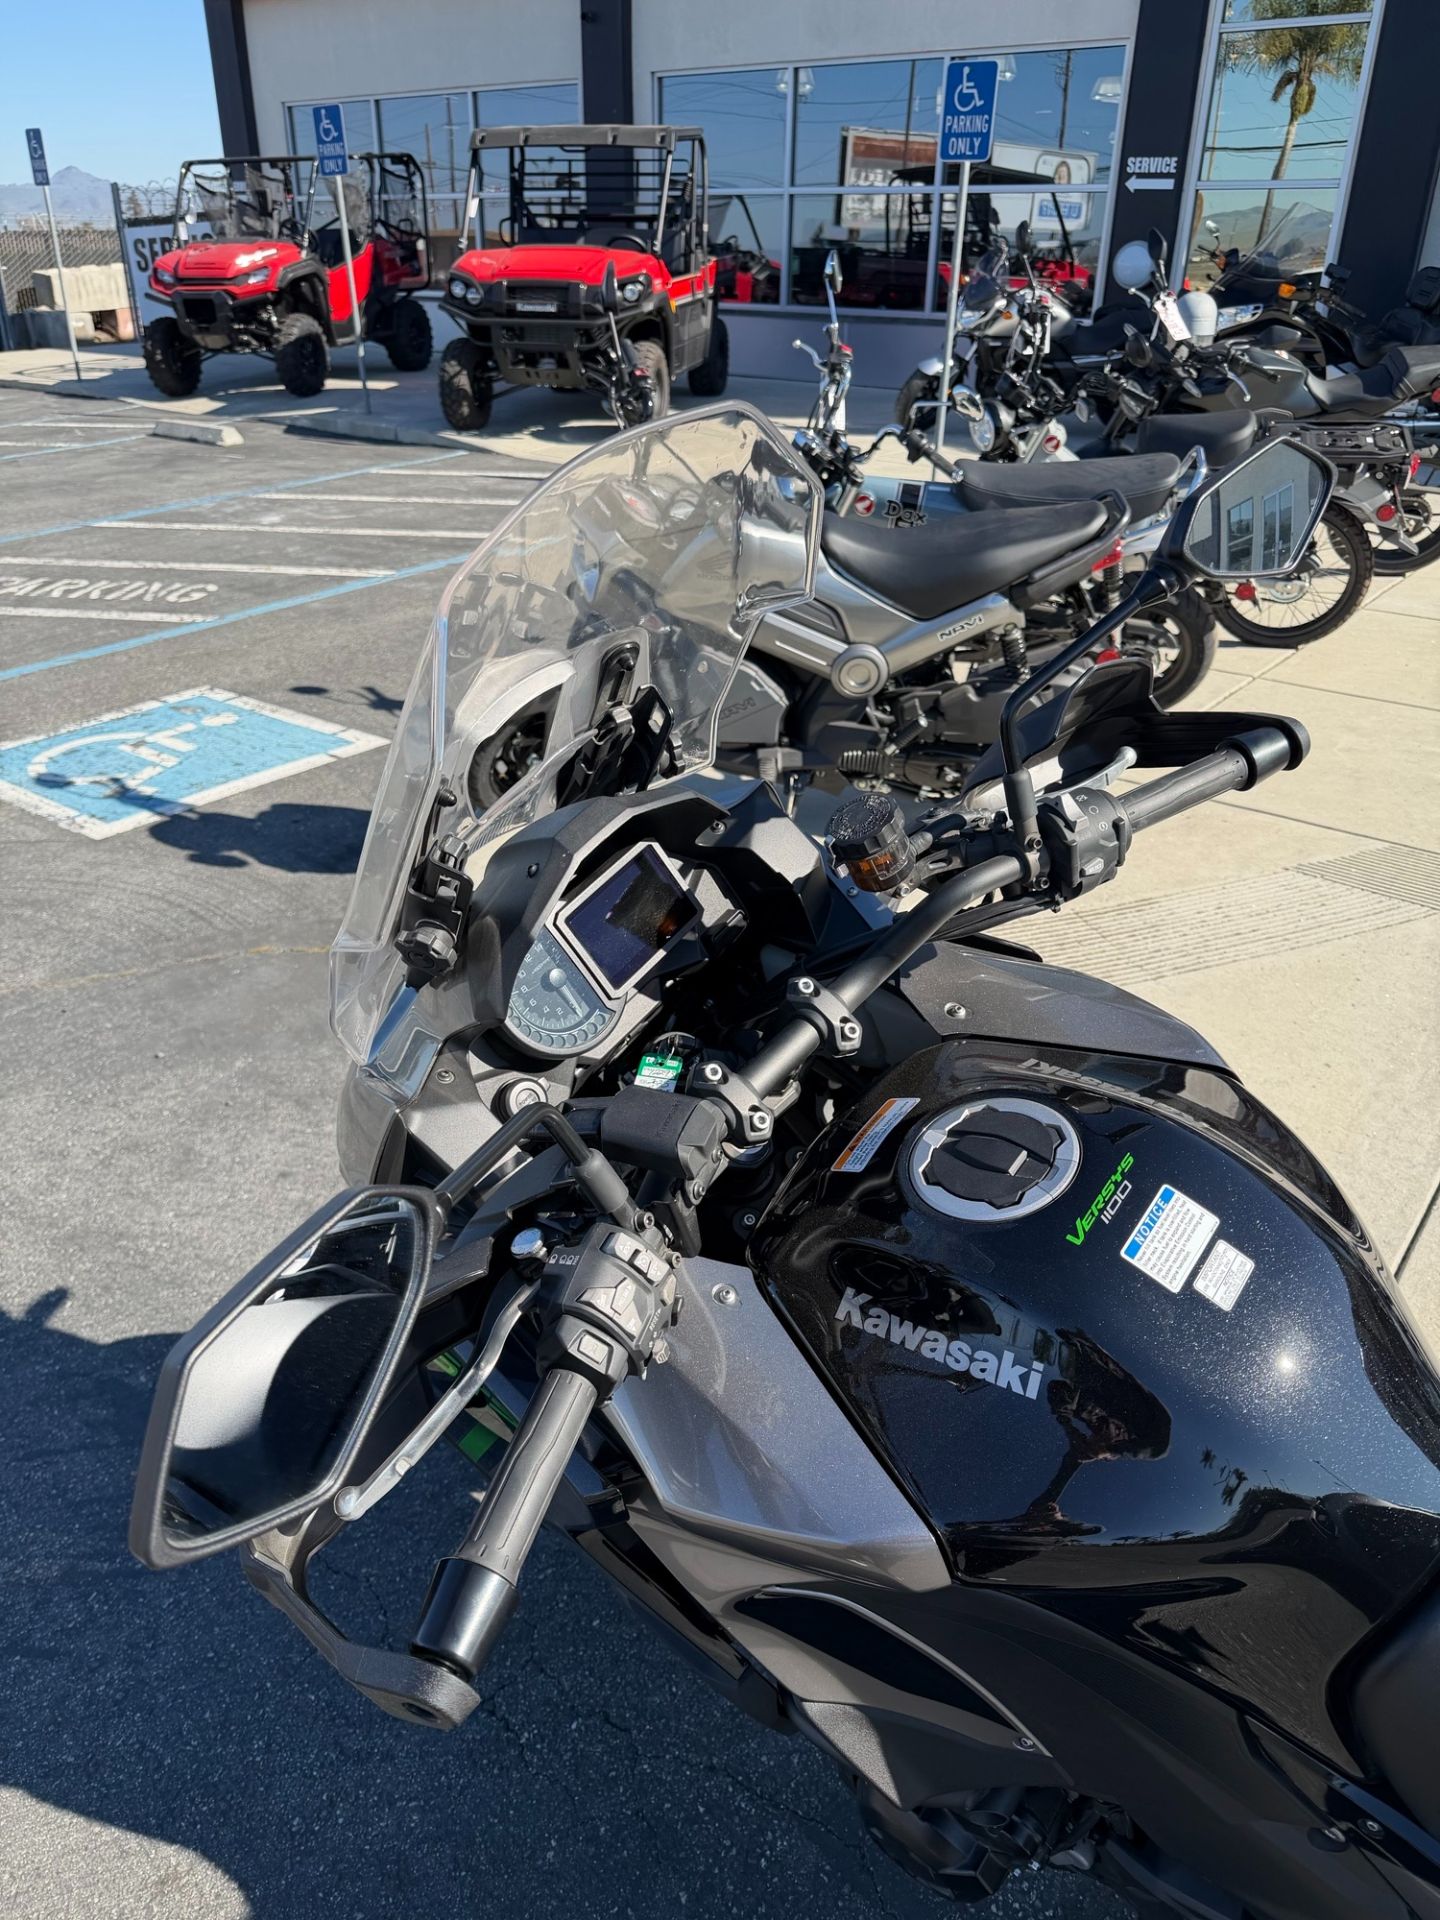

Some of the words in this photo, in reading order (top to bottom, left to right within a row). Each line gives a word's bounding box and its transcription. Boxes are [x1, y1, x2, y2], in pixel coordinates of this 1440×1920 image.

[945, 114, 989, 134] PARKING
[318, 142, 345, 156] PARKING
[948, 137, 982, 156] ONLY
[324, 158, 343, 173] ONLY
[1126, 156, 1178, 173] SERVICE
[882, 499, 928, 526] Dax
[0, 577, 218, 602] PARKING
[936, 614, 984, 642] NAVI
[543, 1006, 550, 1014] 4
[1066, 1152, 1134, 1246] VERSYS
[1100, 1180, 1132, 1224] 1100
[1134, 1198, 1168, 1246] NOTICE
[1161, 1263, 1174, 1280] System
[834, 1286, 1044, 1400] Kawasaki
